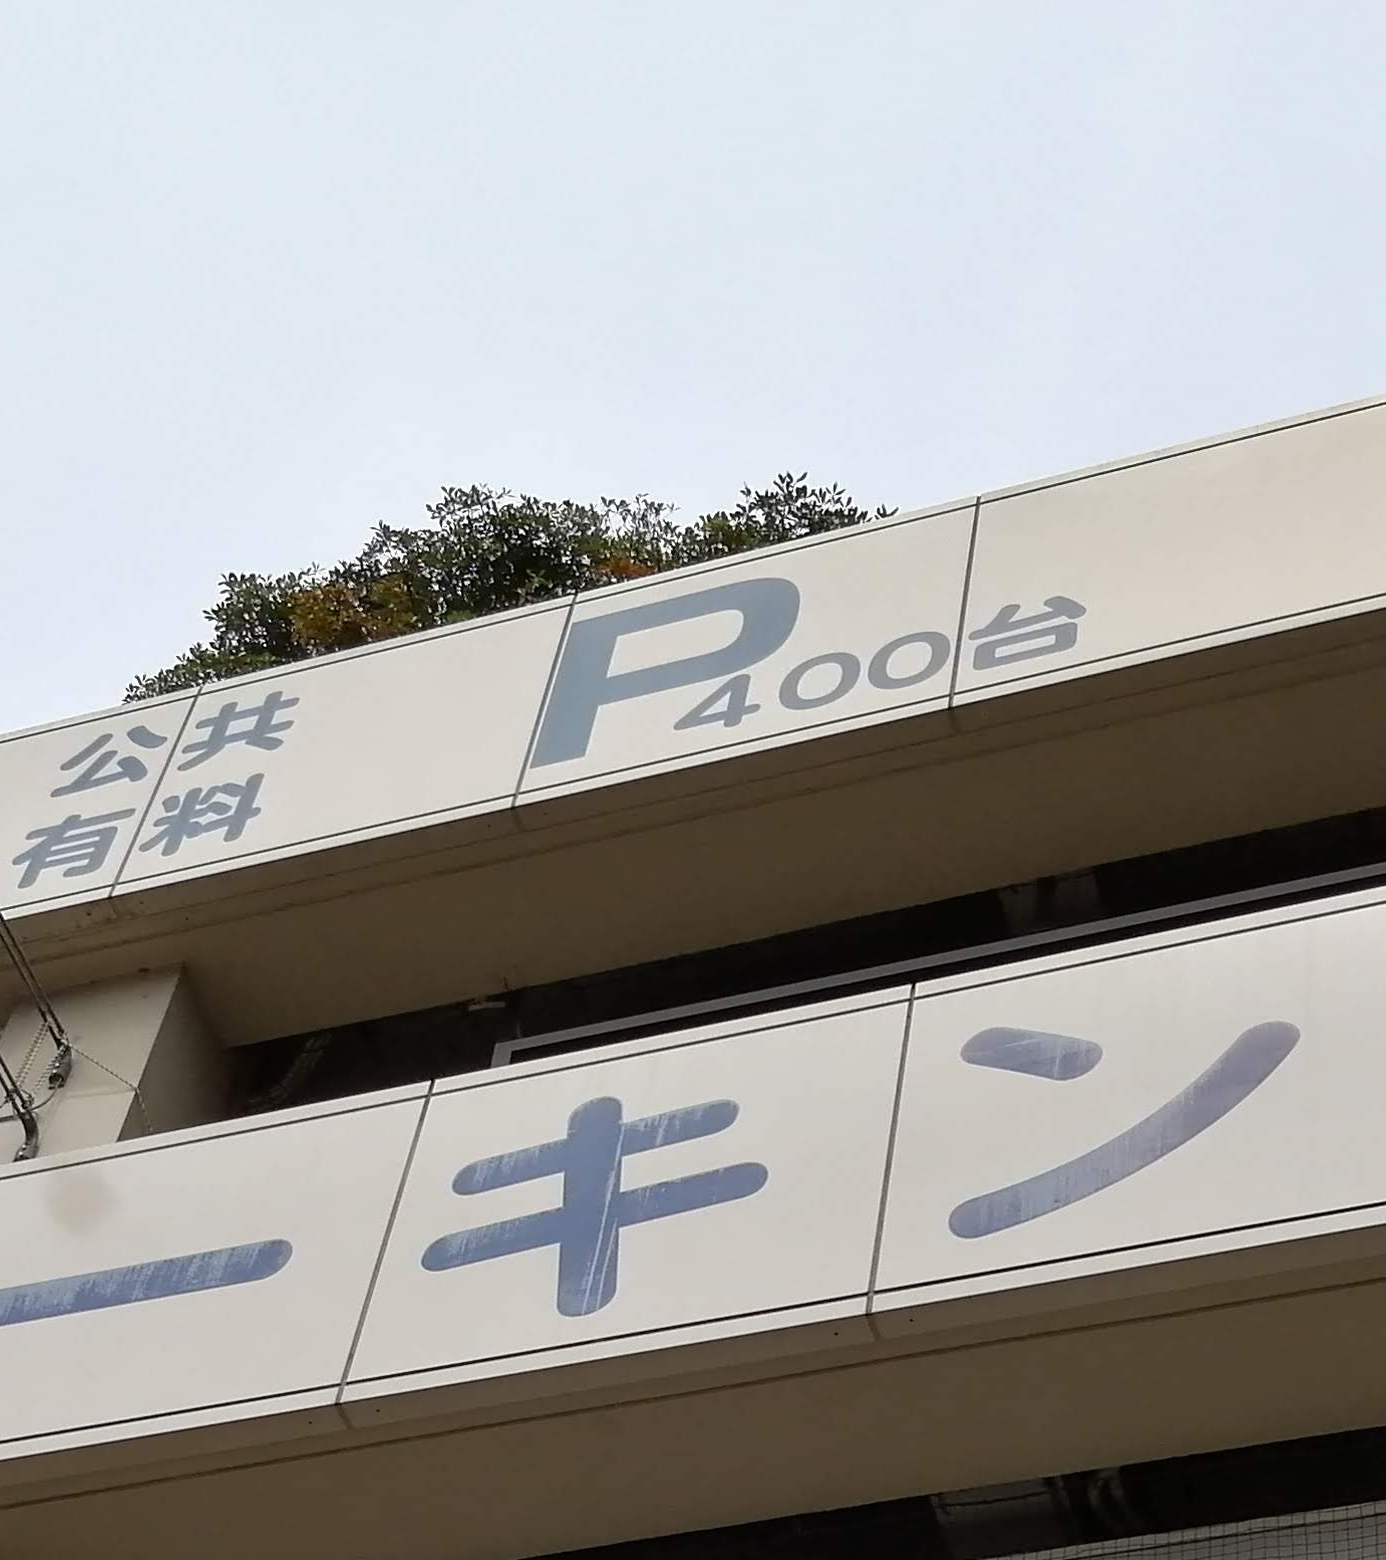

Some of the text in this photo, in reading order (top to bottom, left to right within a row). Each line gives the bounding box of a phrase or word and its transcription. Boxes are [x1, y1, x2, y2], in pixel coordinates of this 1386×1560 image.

[530, 577, 800, 769] P
[672, 595, 1088, 731] 400台
[49, 690, 300, 798] 公共
[12, 772, 265, 889] 有料
